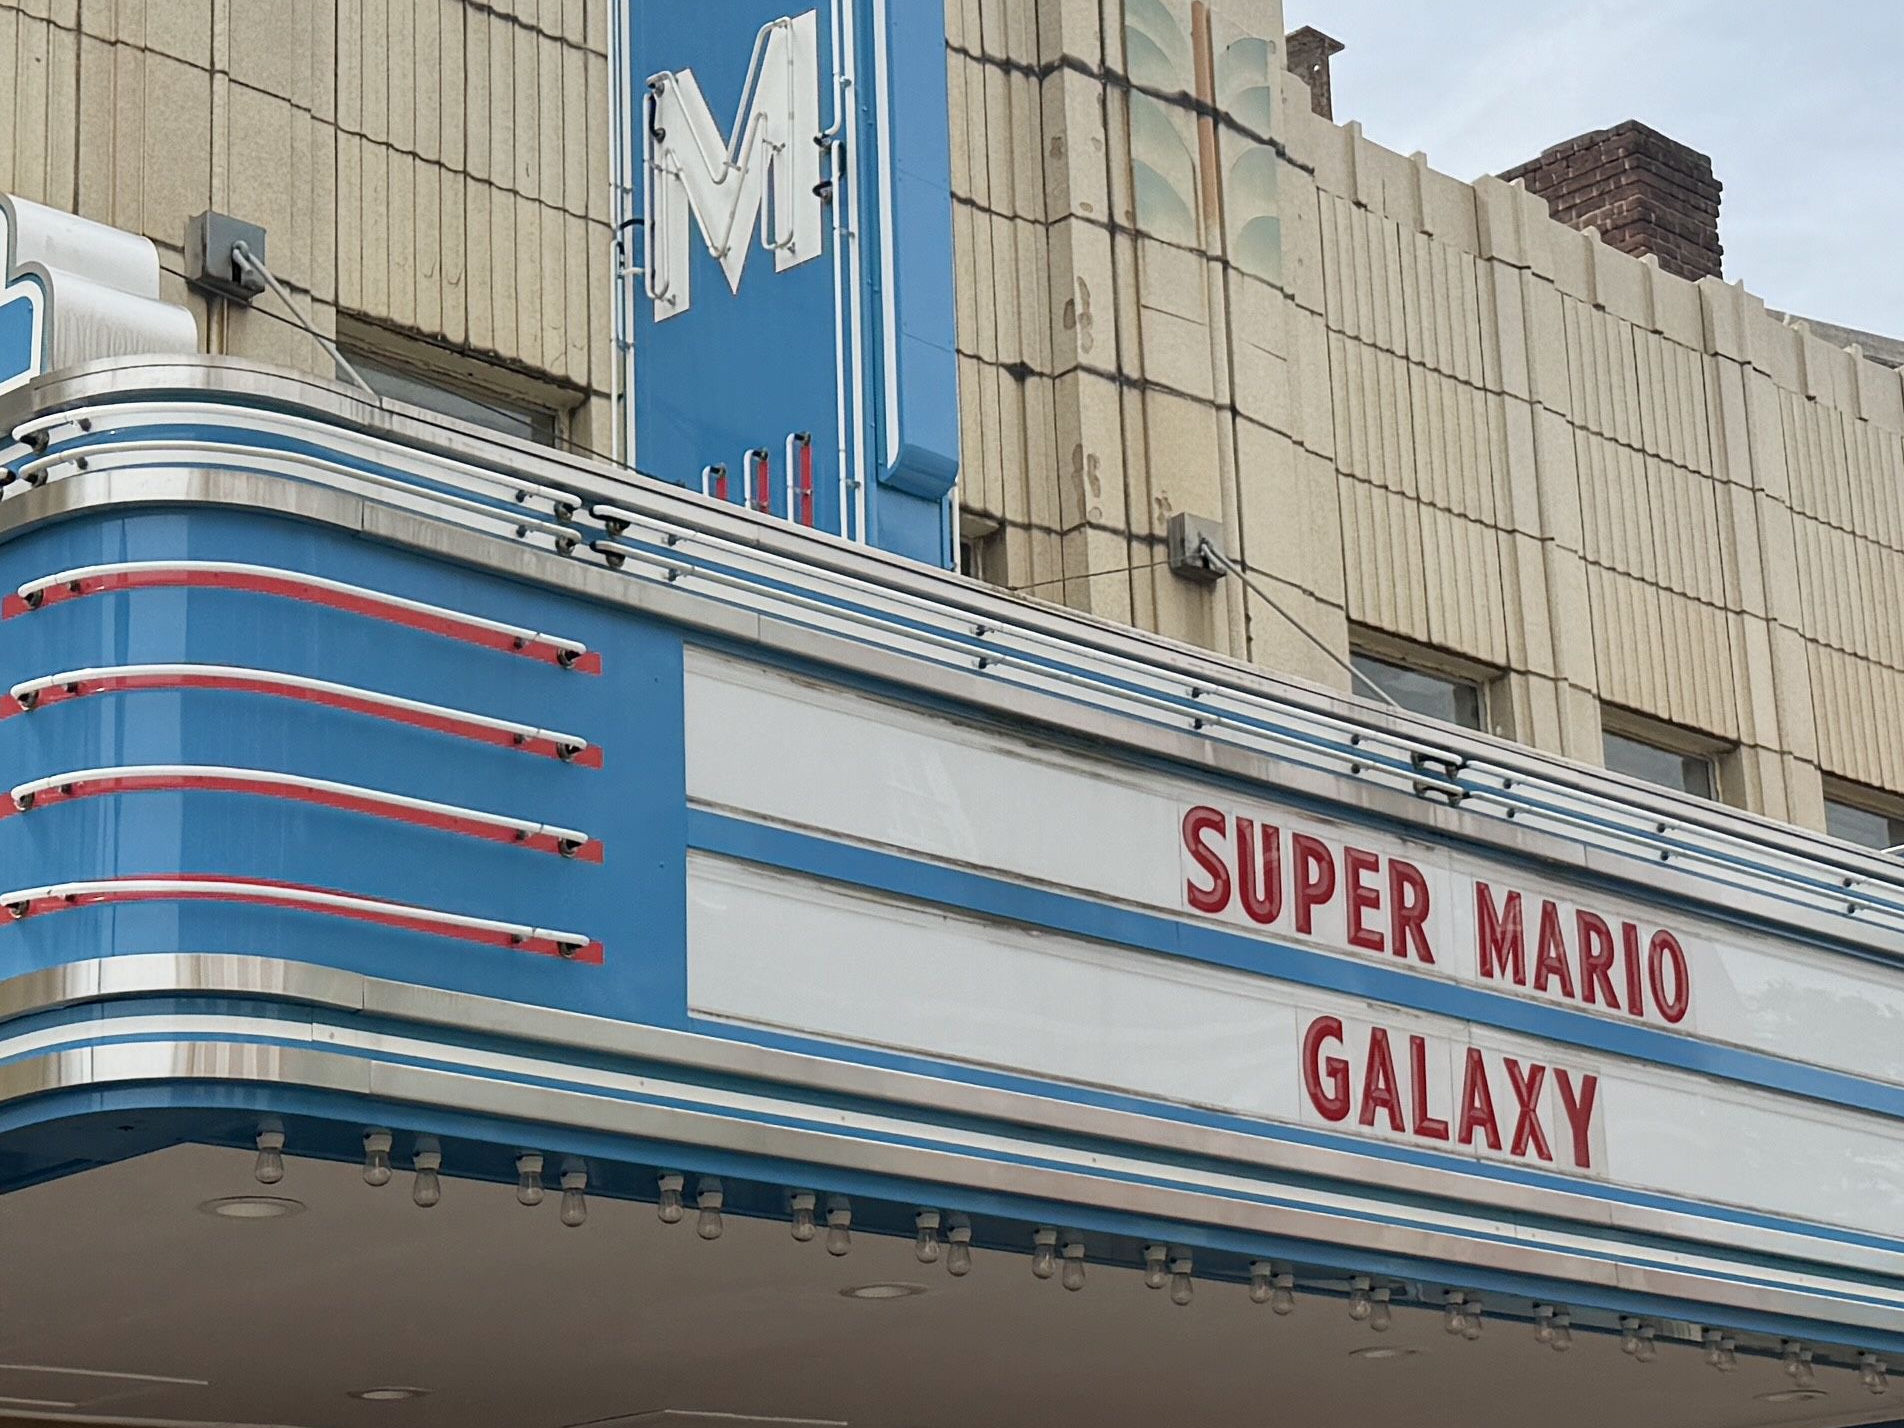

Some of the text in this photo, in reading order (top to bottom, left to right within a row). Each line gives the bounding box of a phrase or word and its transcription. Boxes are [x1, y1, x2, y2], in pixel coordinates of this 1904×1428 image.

[1181, 804, 1690, 1024] SUPER MARIO
[1302, 1015, 1598, 1169] GALAXY
